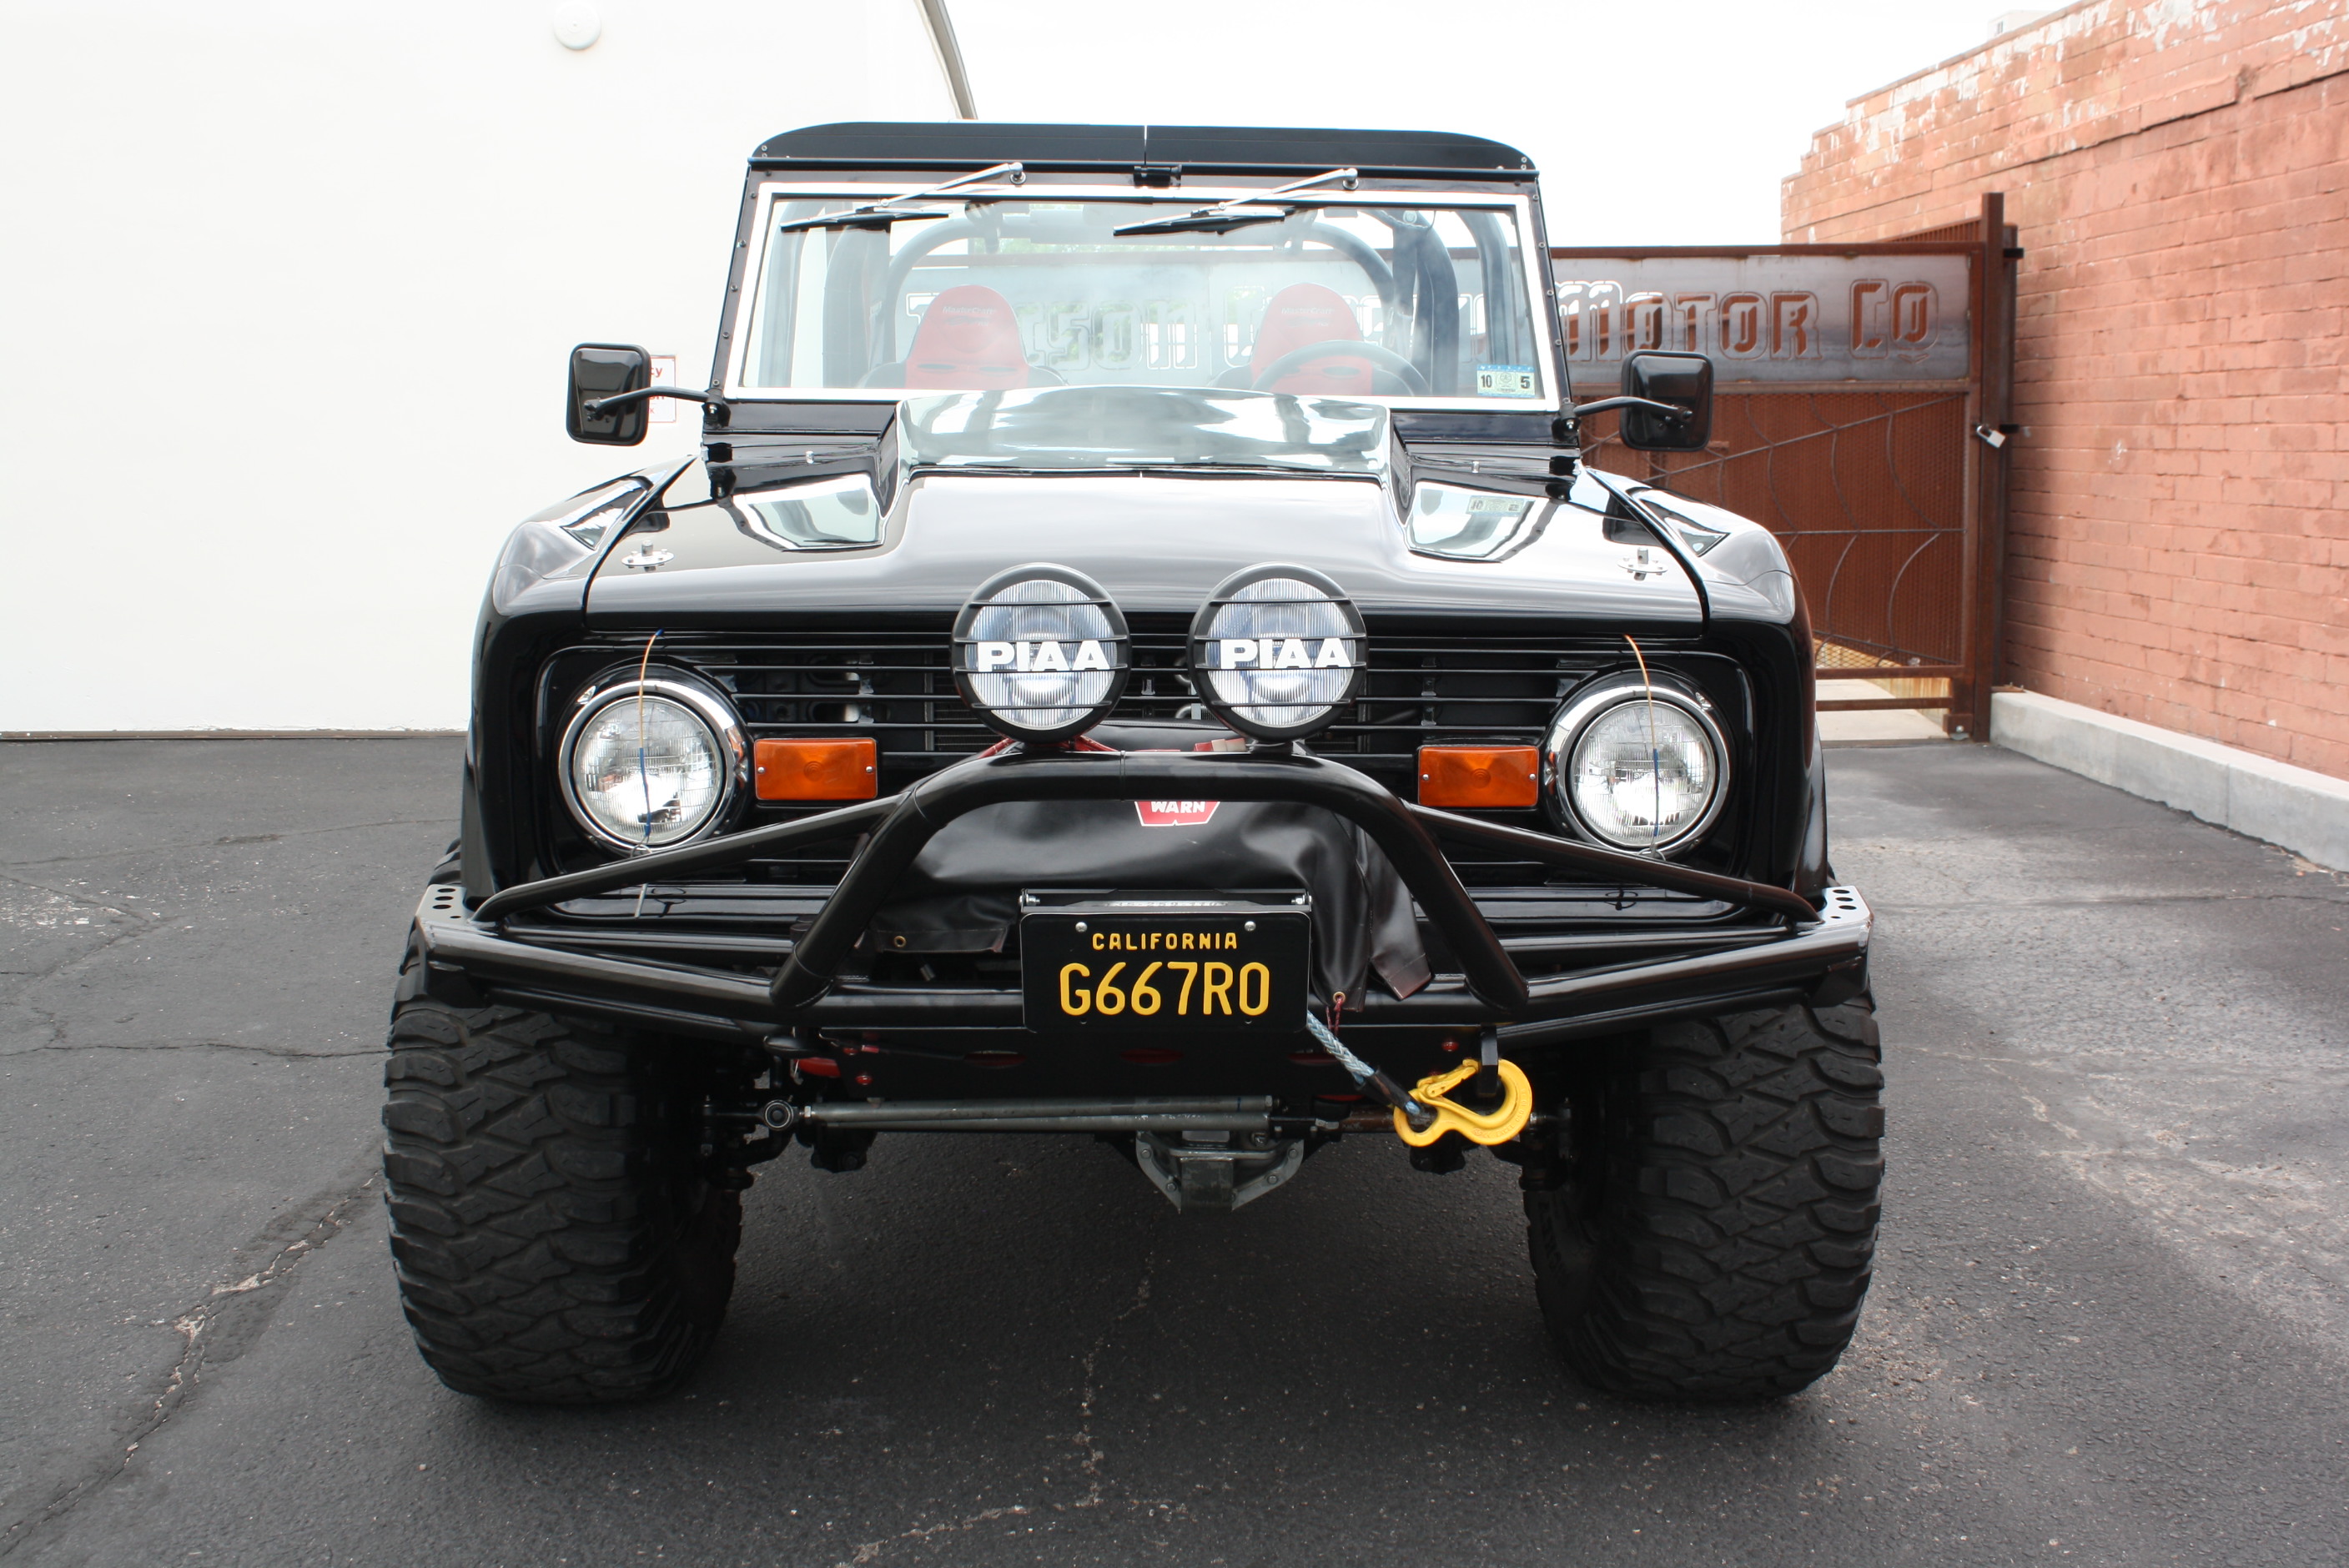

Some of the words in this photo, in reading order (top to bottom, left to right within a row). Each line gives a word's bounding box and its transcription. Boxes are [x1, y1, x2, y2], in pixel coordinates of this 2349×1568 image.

[1481, 374, 1493, 389] 10
[1520, 374, 1532, 389] 5
[977, 640, 1111, 672] PIAA
[1220, 638, 1352, 671] PIAA
[1151, 801, 1206, 814] WARN
[1092, 932, 1238, 951] CALIFORNIA
